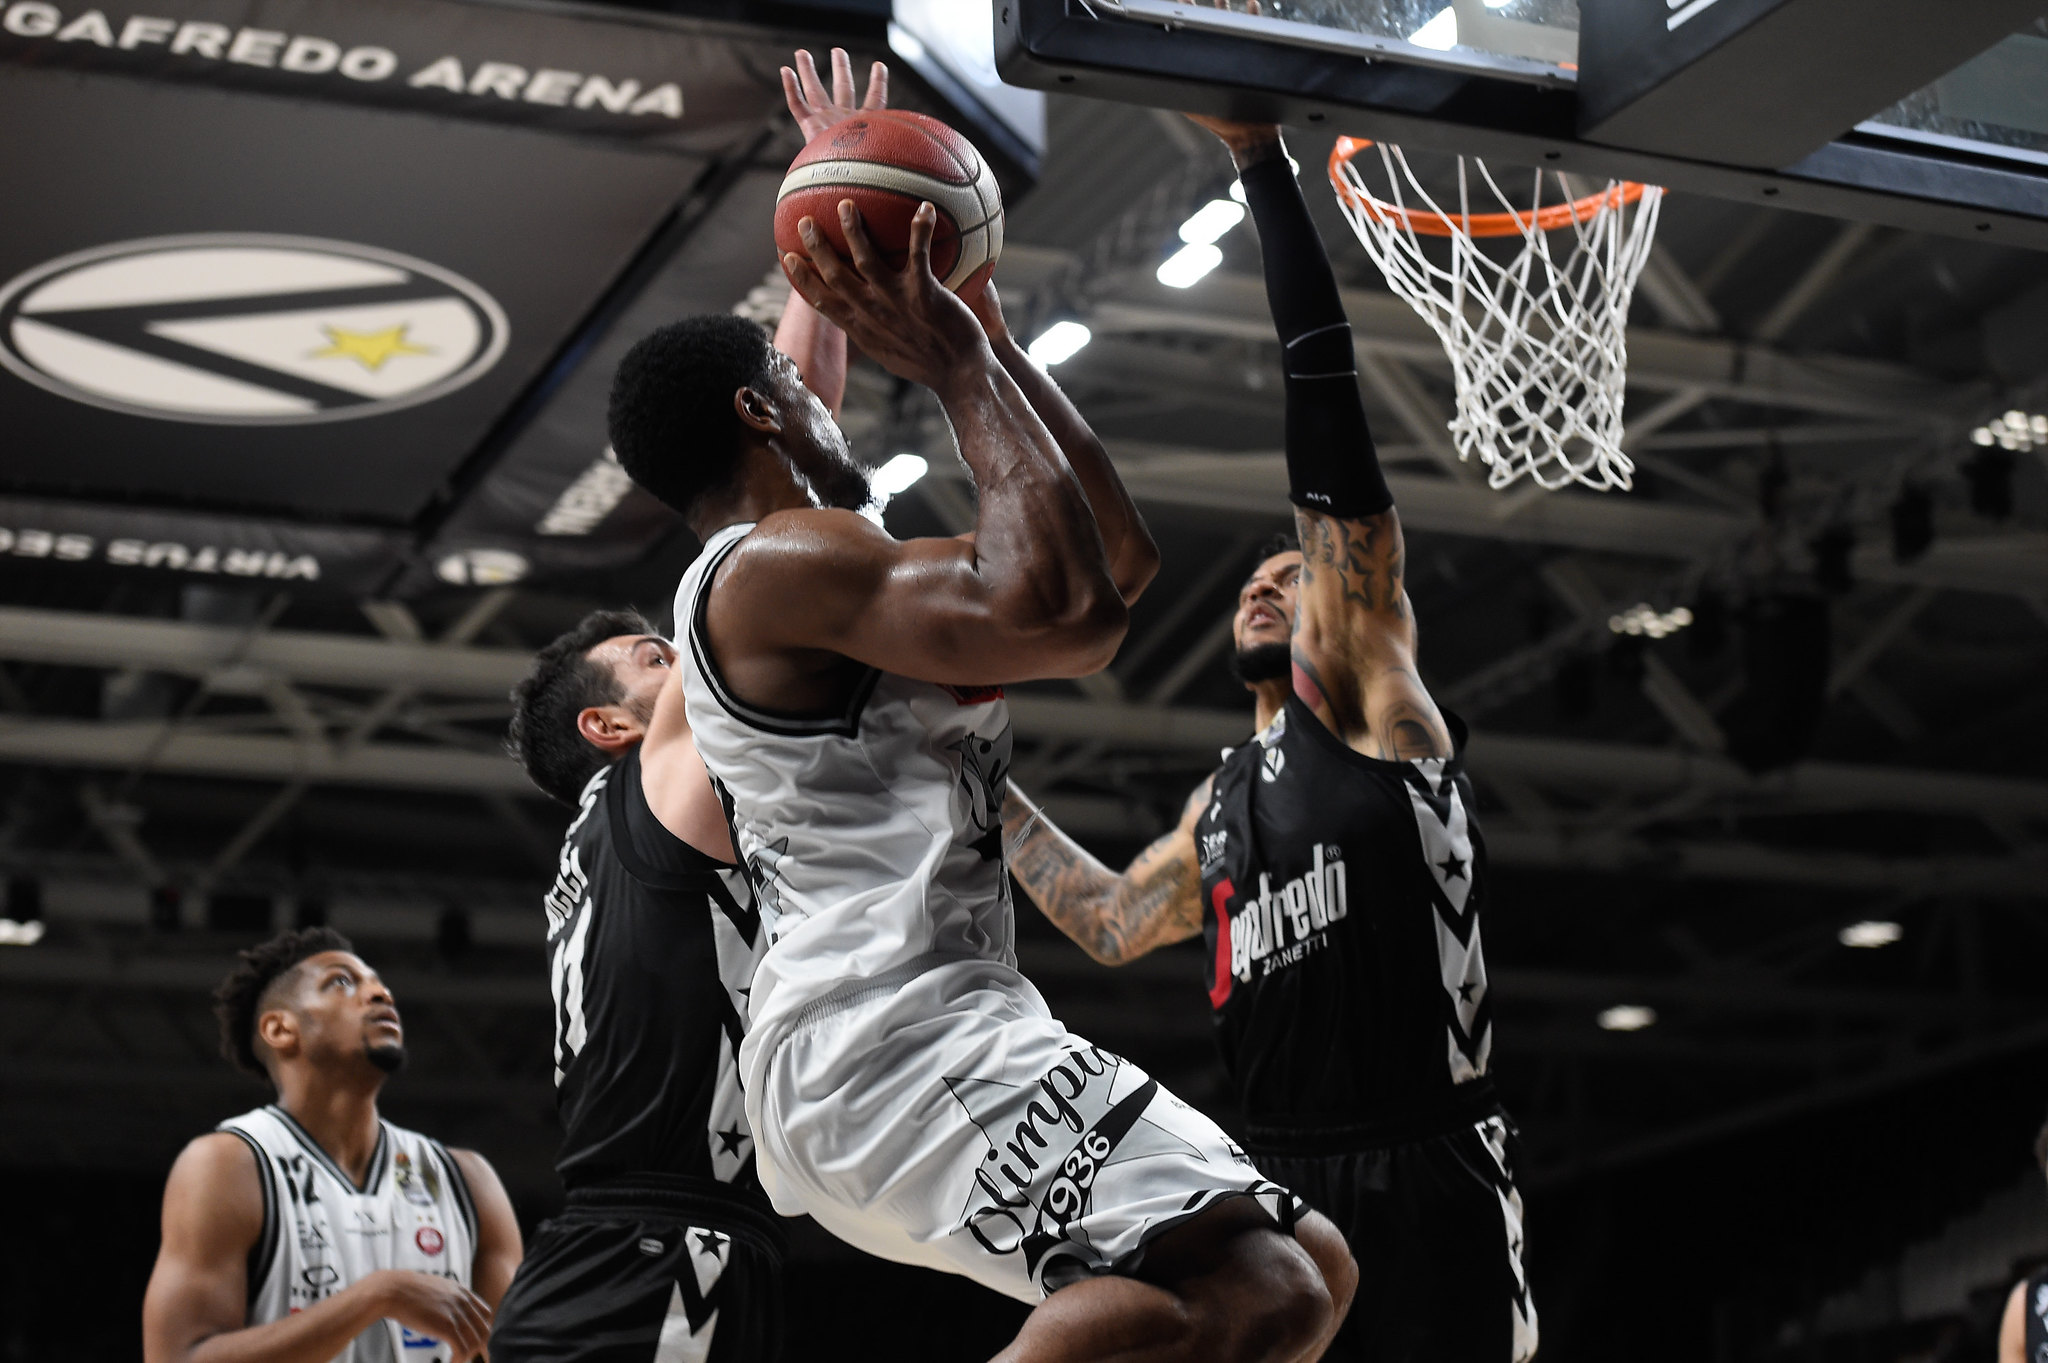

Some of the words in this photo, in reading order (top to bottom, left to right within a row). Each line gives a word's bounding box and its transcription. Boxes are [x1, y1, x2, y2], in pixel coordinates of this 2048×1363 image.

[0, 0, 399, 82] GAFREDO
[406, 55, 686, 119] ARENA
[106, 538, 321, 581] VIRTUS
[1262, 931, 1328, 977] ZANETTI
